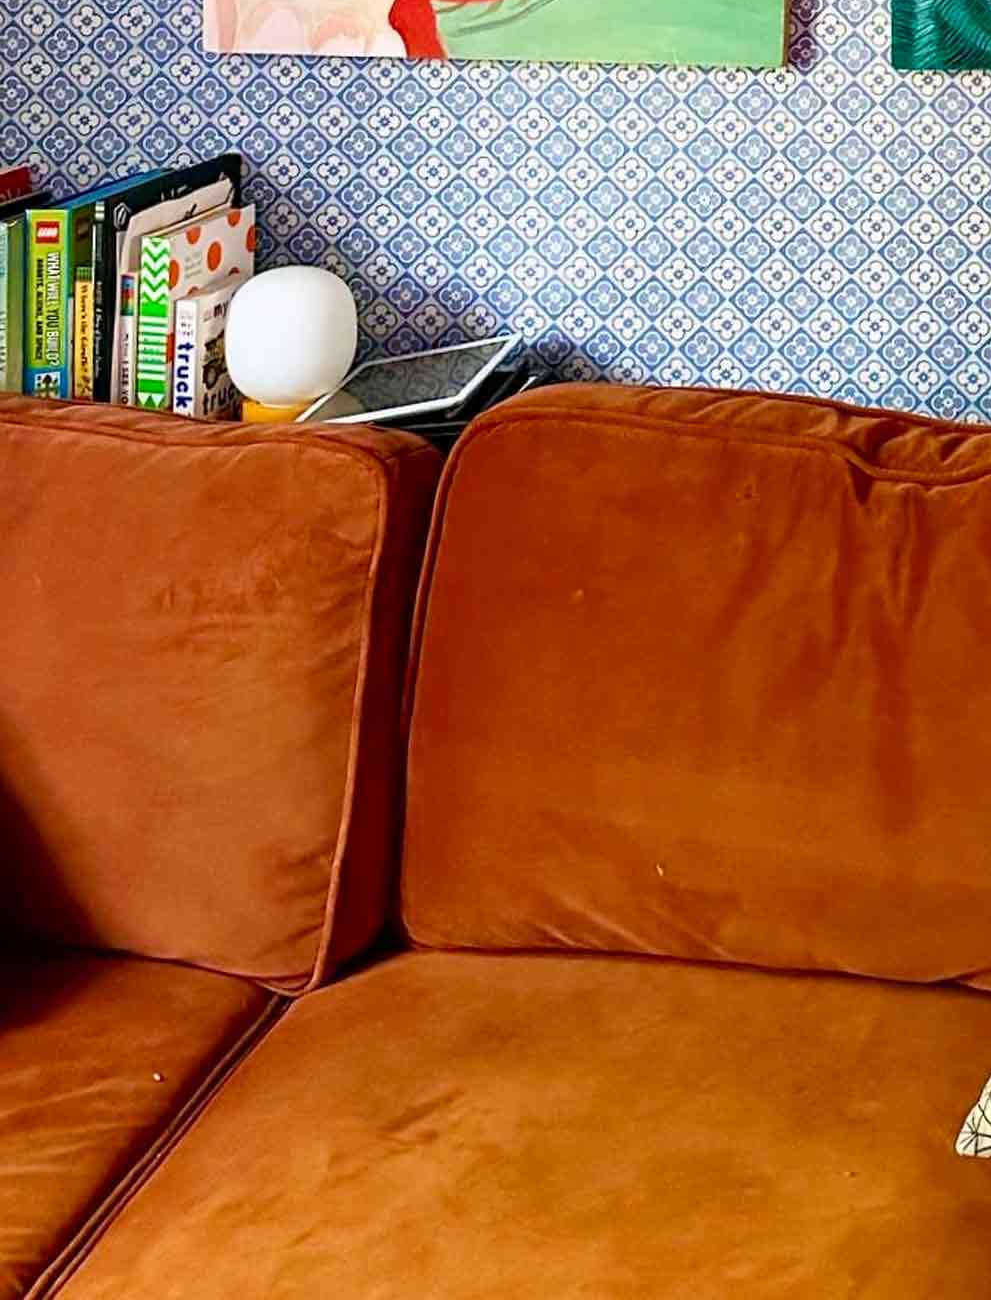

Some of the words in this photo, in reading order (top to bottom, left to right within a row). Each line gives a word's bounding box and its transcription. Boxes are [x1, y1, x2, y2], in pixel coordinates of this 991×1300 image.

[47, 252, 60, 280] WHAT
[47, 283, 60, 304] WILL
[47, 309, 60, 328] YOU
[46, 331, 60, 366] BUILD?
[176, 342, 195, 408] truck
